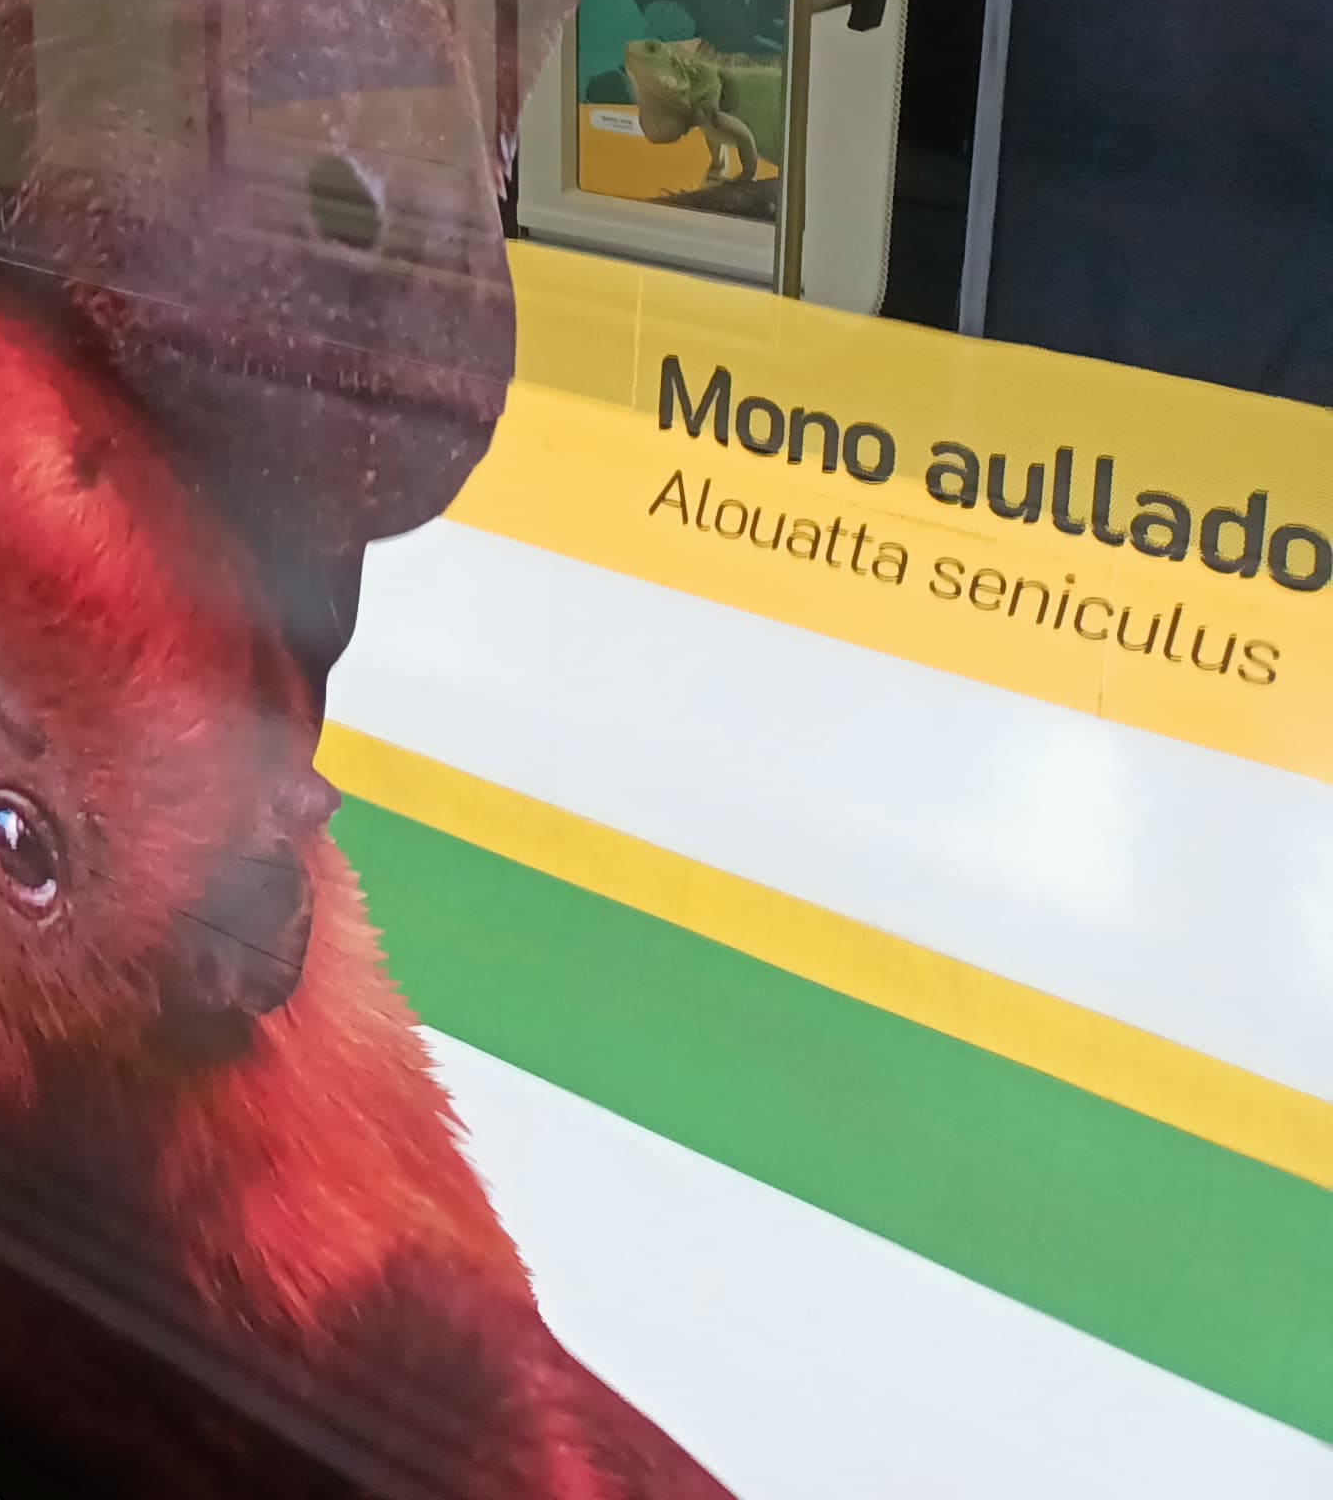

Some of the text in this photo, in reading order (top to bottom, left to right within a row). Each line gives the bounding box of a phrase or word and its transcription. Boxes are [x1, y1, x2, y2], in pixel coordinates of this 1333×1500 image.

[648, 468, 1281, 686] Alouatta seniculus
[659, 354, 1333, 593] Mono aullado
